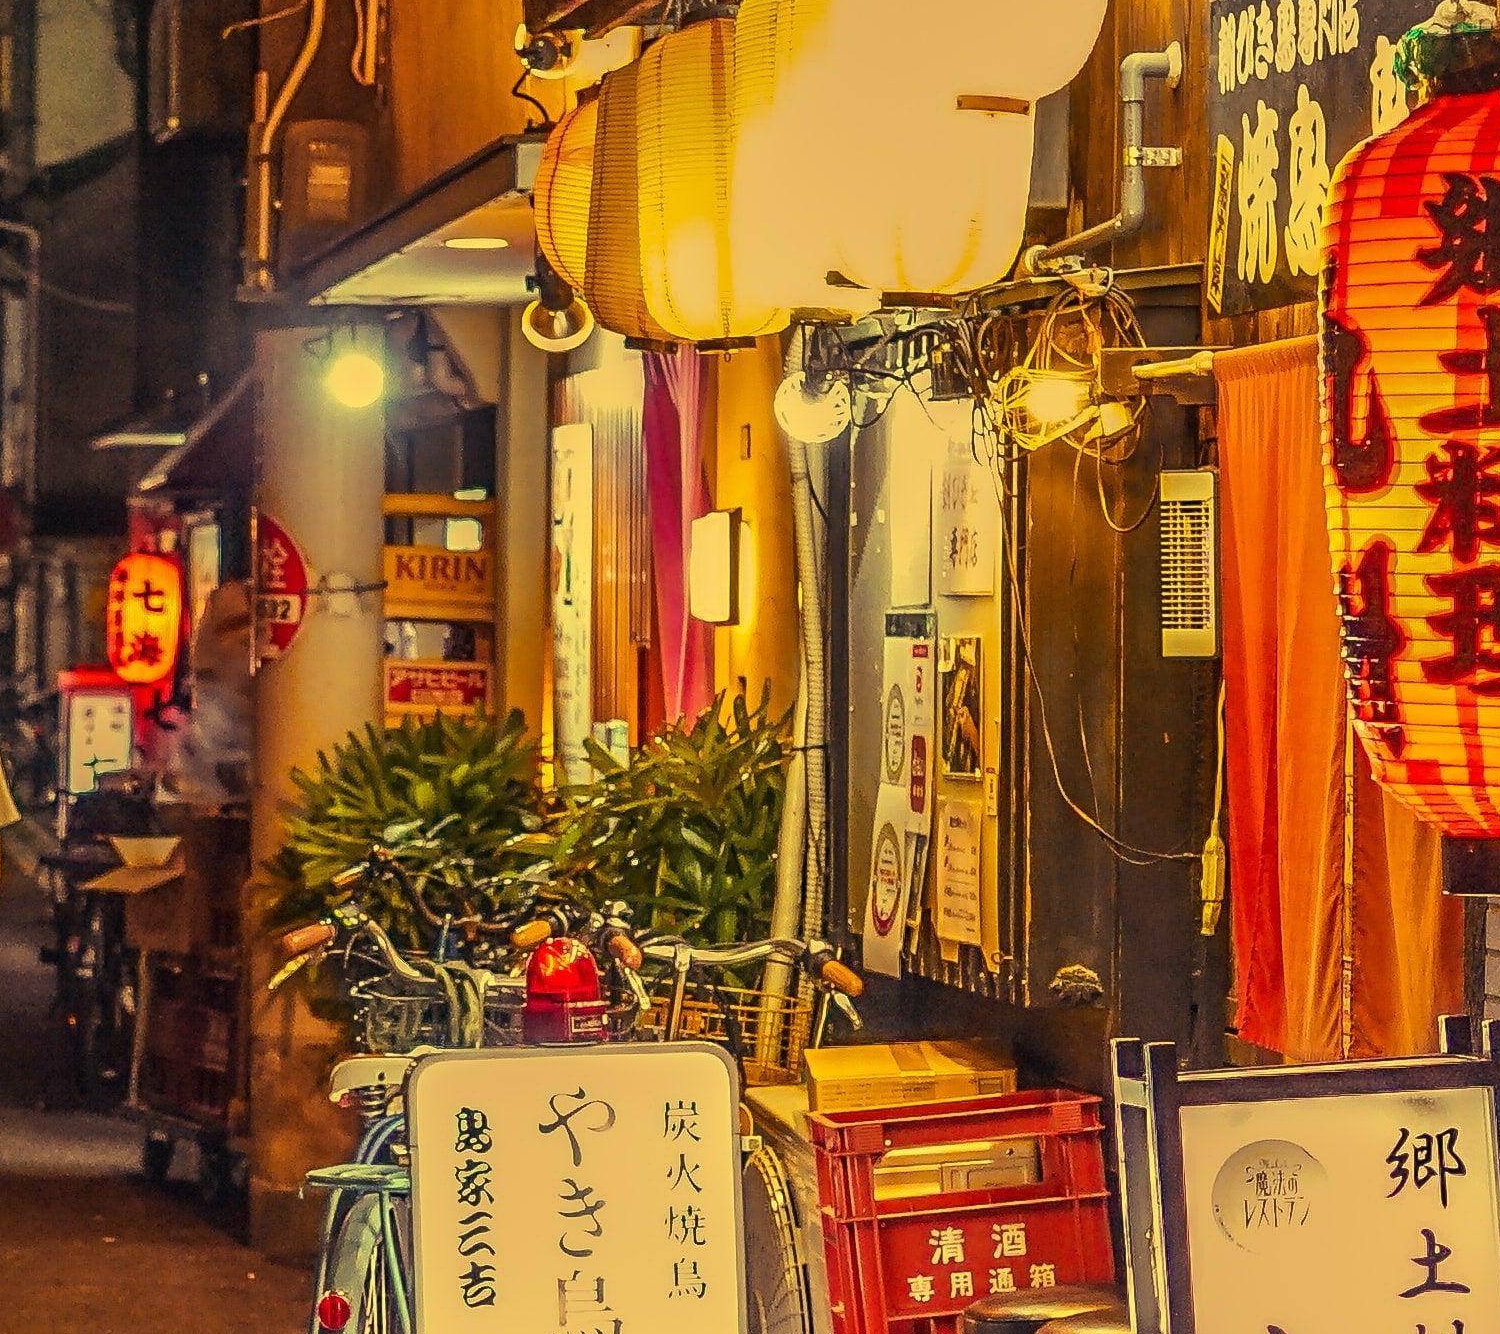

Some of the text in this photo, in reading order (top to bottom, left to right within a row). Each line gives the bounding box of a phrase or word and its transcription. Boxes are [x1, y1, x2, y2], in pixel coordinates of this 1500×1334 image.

[395, 554, 487, 582] KIRIN
[661, 1099, 708, 1302] 炭火焼鳥
[928, 1222, 1028, 1265] 清酒
